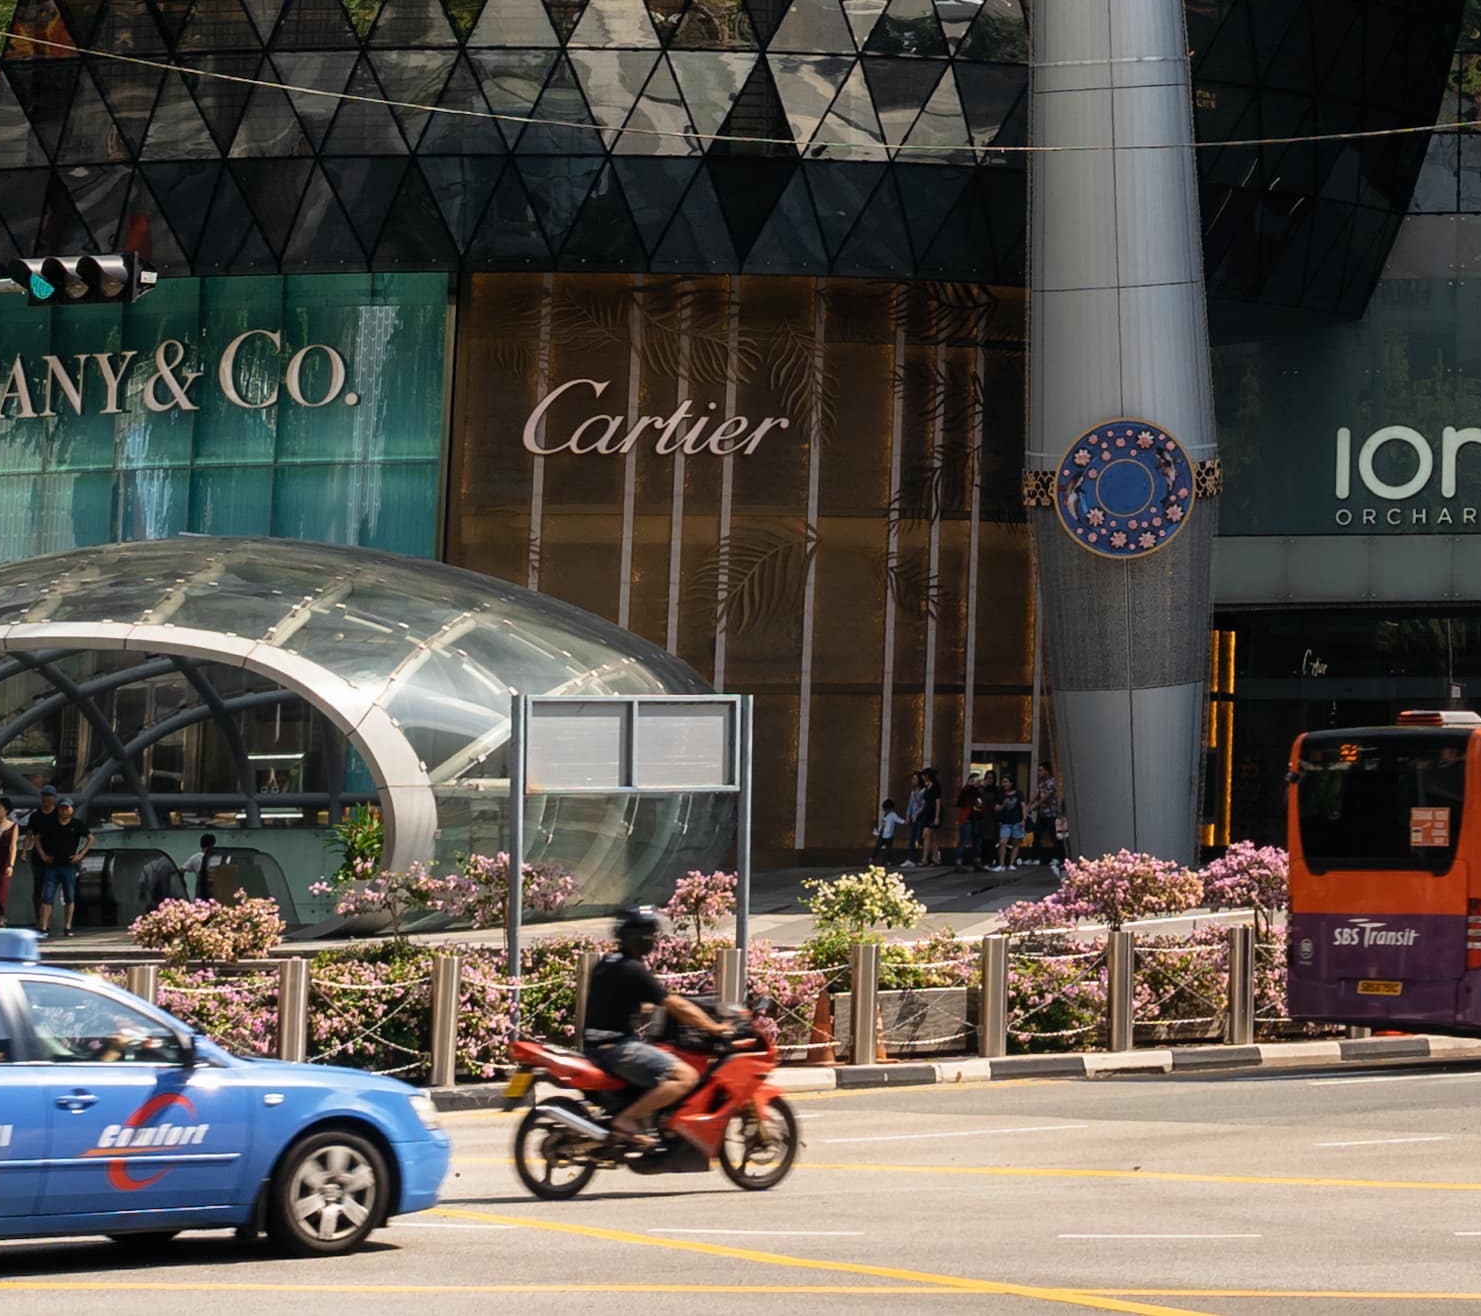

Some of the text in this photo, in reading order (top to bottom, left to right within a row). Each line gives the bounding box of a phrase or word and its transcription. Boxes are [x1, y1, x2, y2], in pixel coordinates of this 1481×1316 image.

[144, 339, 204, 412] &
[222, 329, 362, 408] Co.
[522, 378, 790, 455] Cartier
[1333, 922, 1420, 948] SBS Transit
[97, 1124, 209, 1148] Comfort
